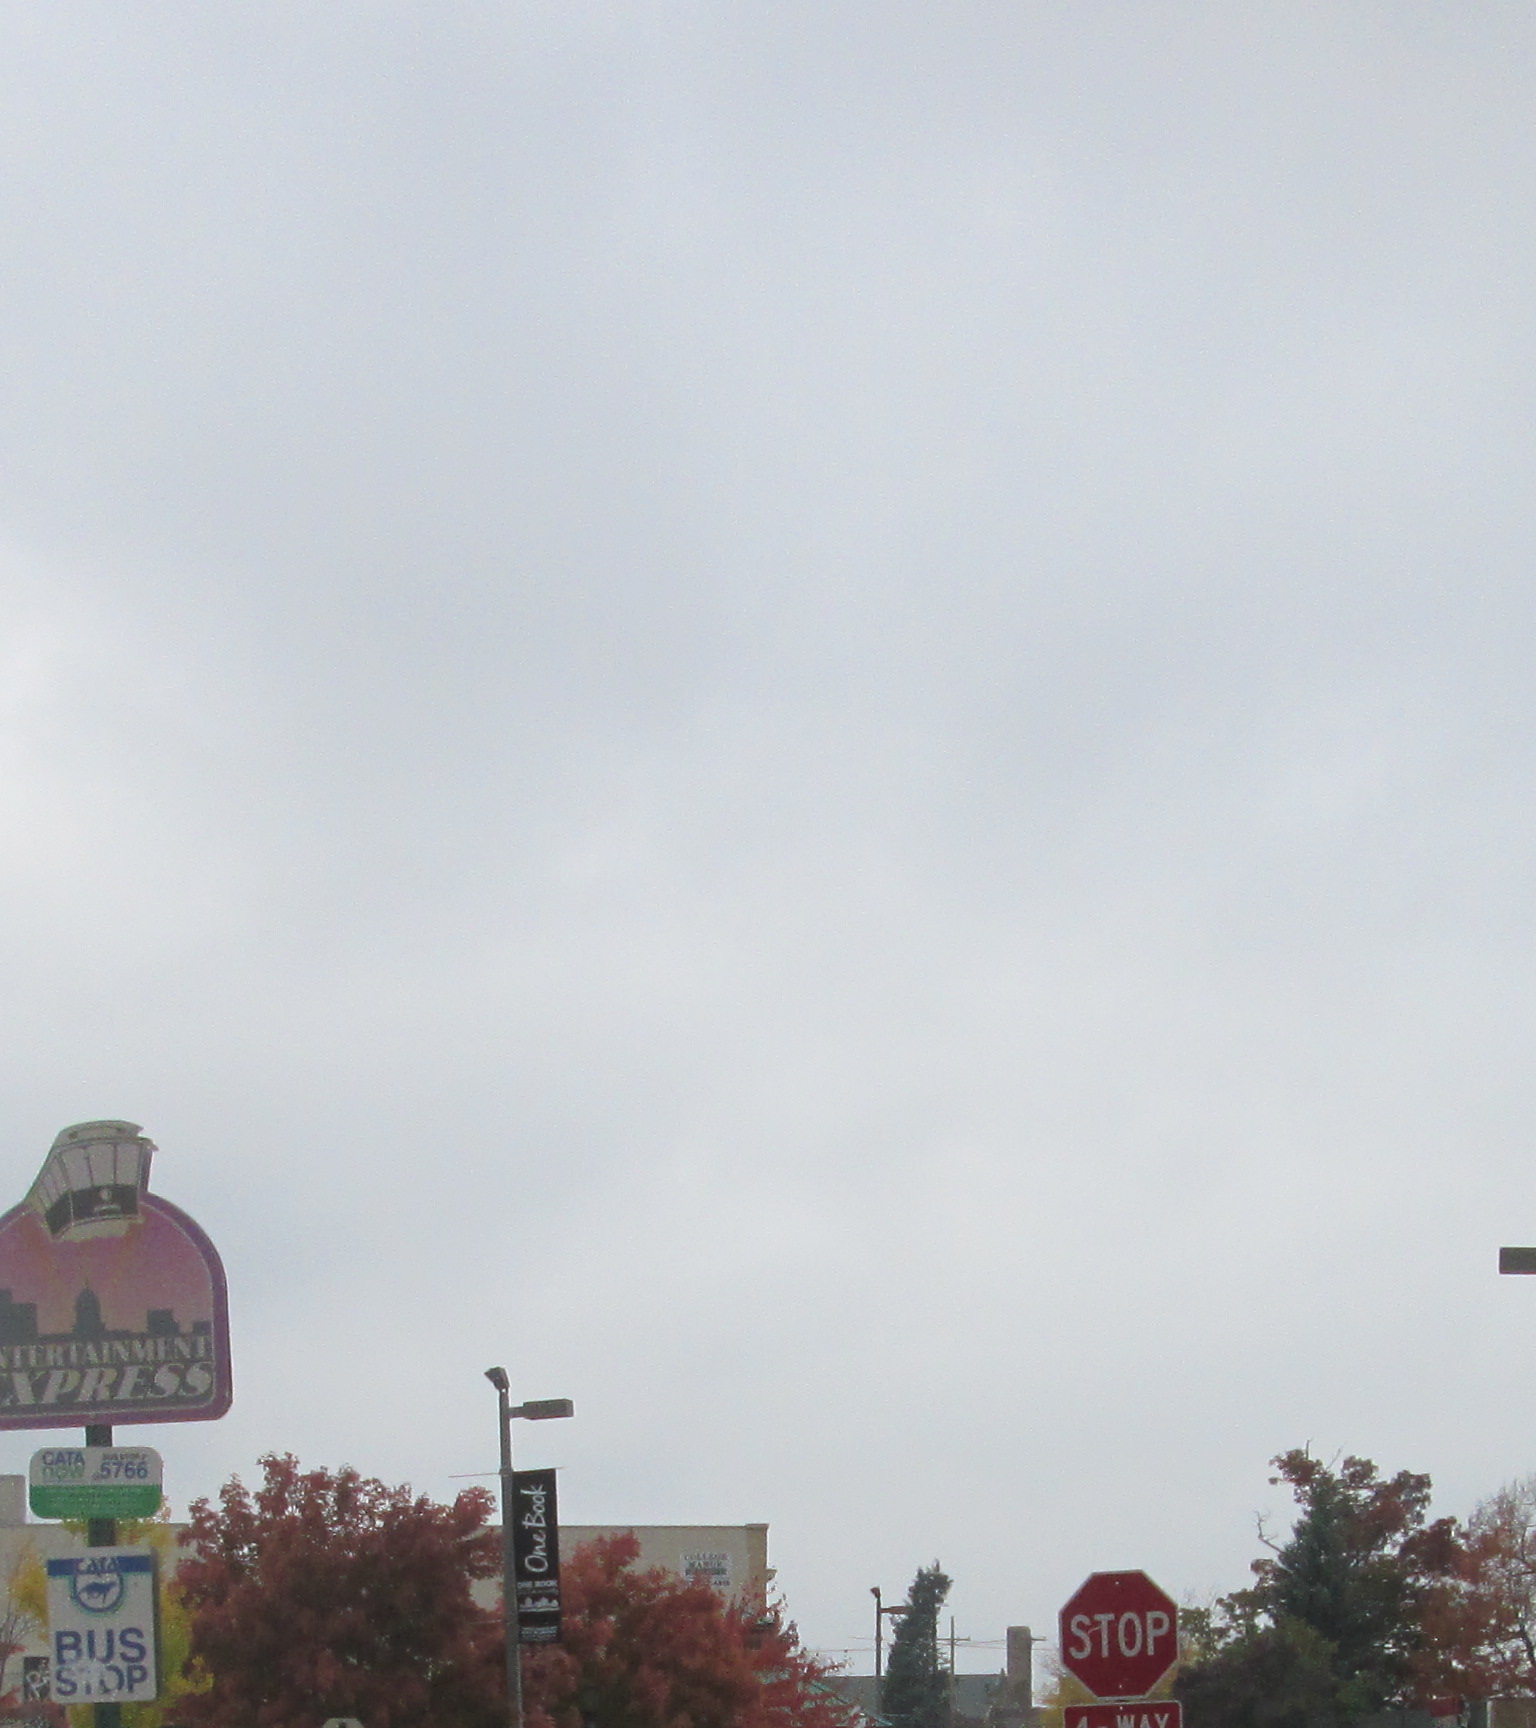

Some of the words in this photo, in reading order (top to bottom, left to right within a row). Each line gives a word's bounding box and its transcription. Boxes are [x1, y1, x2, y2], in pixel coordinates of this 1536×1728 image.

[43, 1451, 85, 1466] CATA
[100, 1461, 148, 1479] 5766
[520, 1483, 547, 1529] Book
[75, 1556, 119, 1576] CATA
[524, 1529, 548, 1572] One
[55, 1627, 147, 1666] BUS
[1069, 1611, 1170, 1659] STOP
